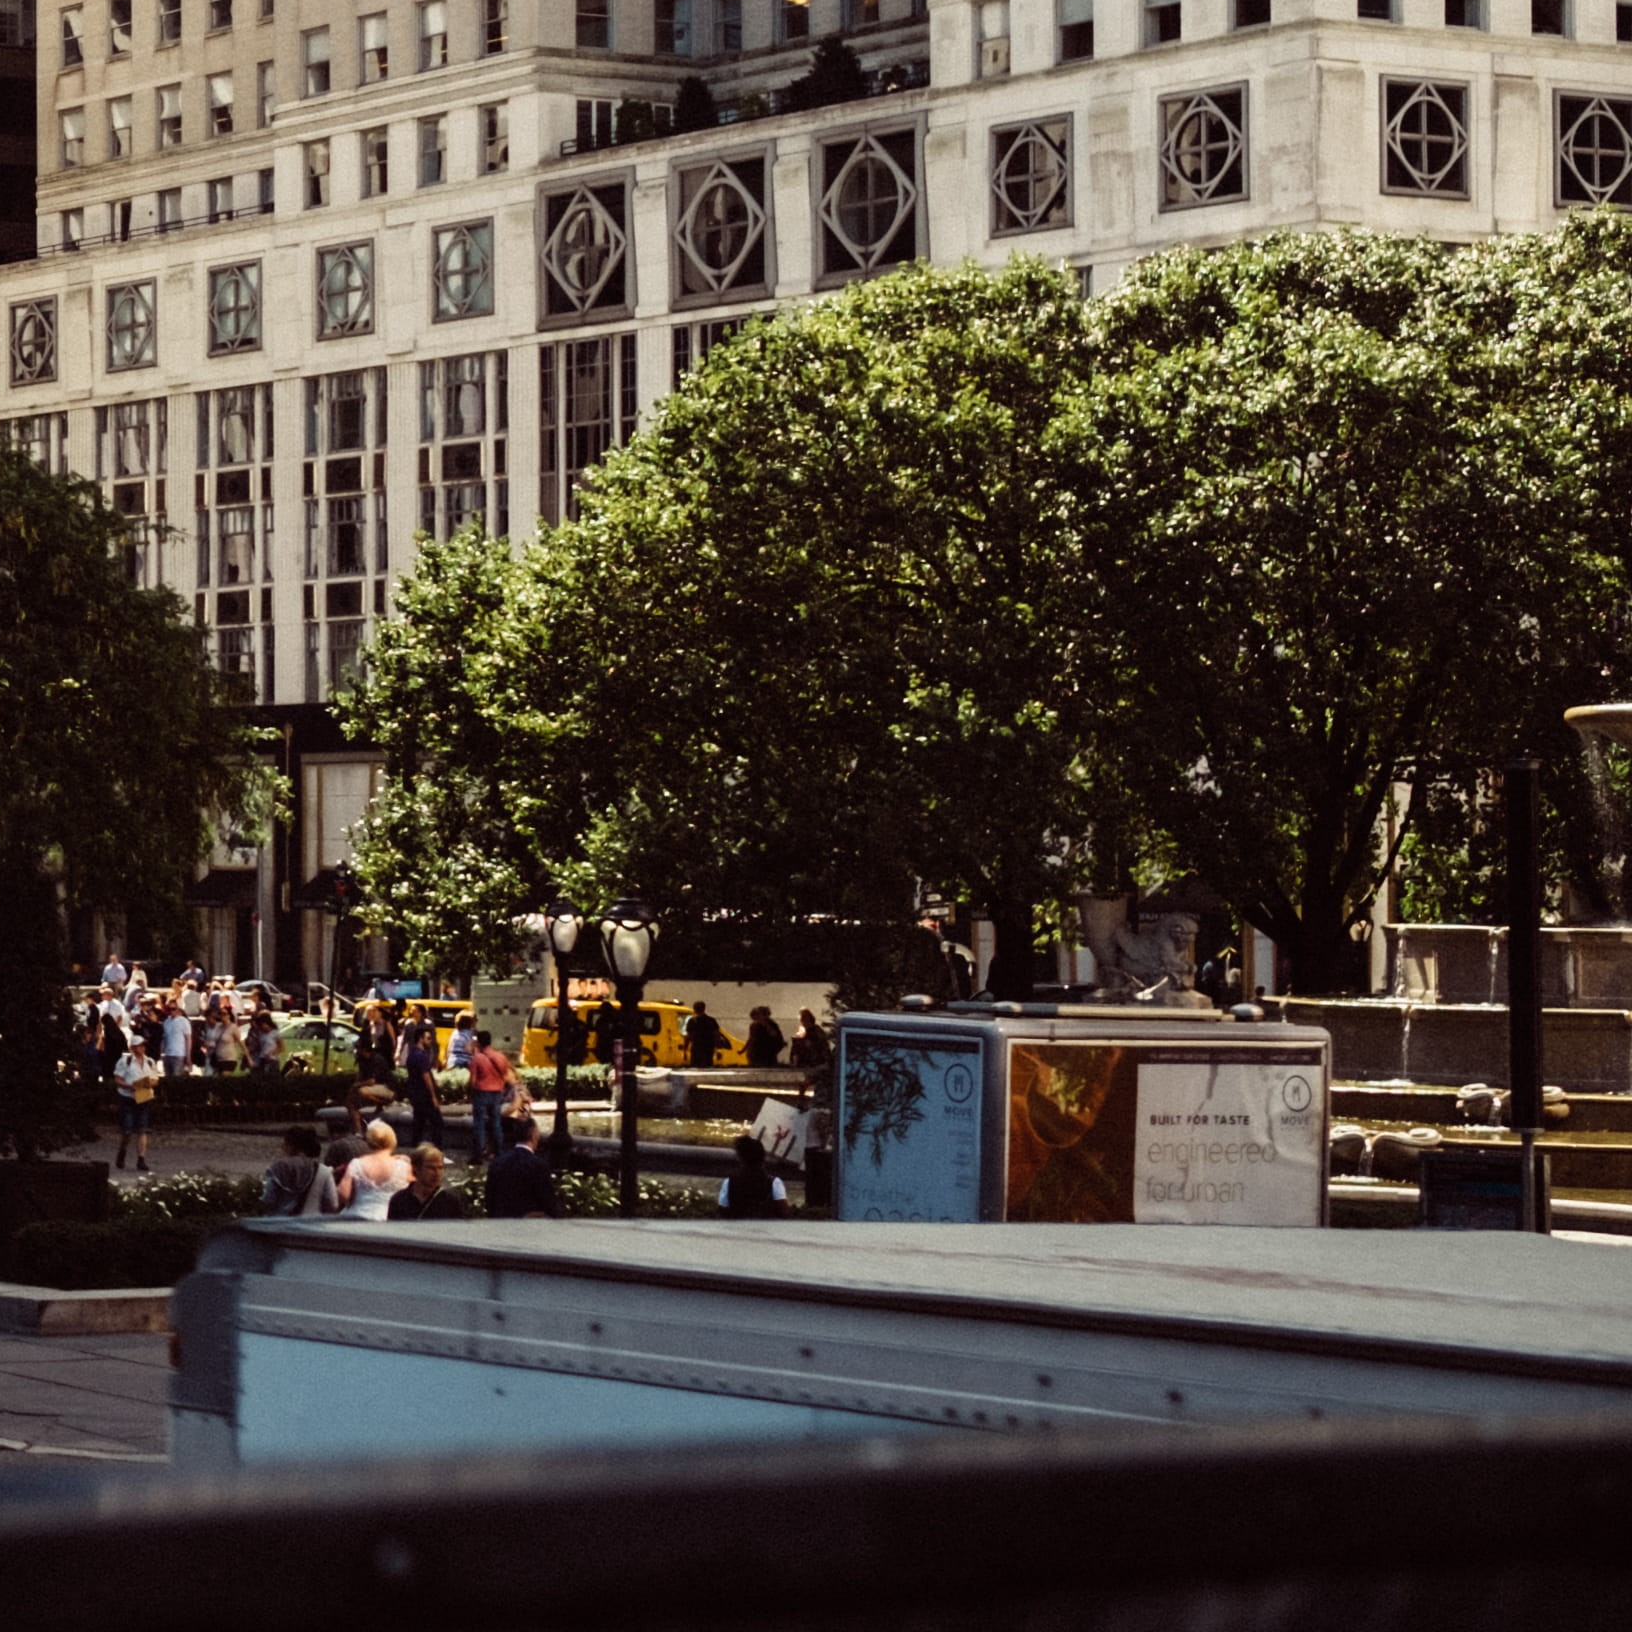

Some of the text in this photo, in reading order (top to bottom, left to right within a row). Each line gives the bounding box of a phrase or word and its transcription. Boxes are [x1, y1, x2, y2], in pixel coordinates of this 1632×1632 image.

[1149, 1115, 1251, 1125] BUILT FOR TASTE
[1281, 1115, 1311, 1126] MOVE
[1147, 1142, 1279, 1170] engineered
[1146, 1175, 1245, 1203] for urban
